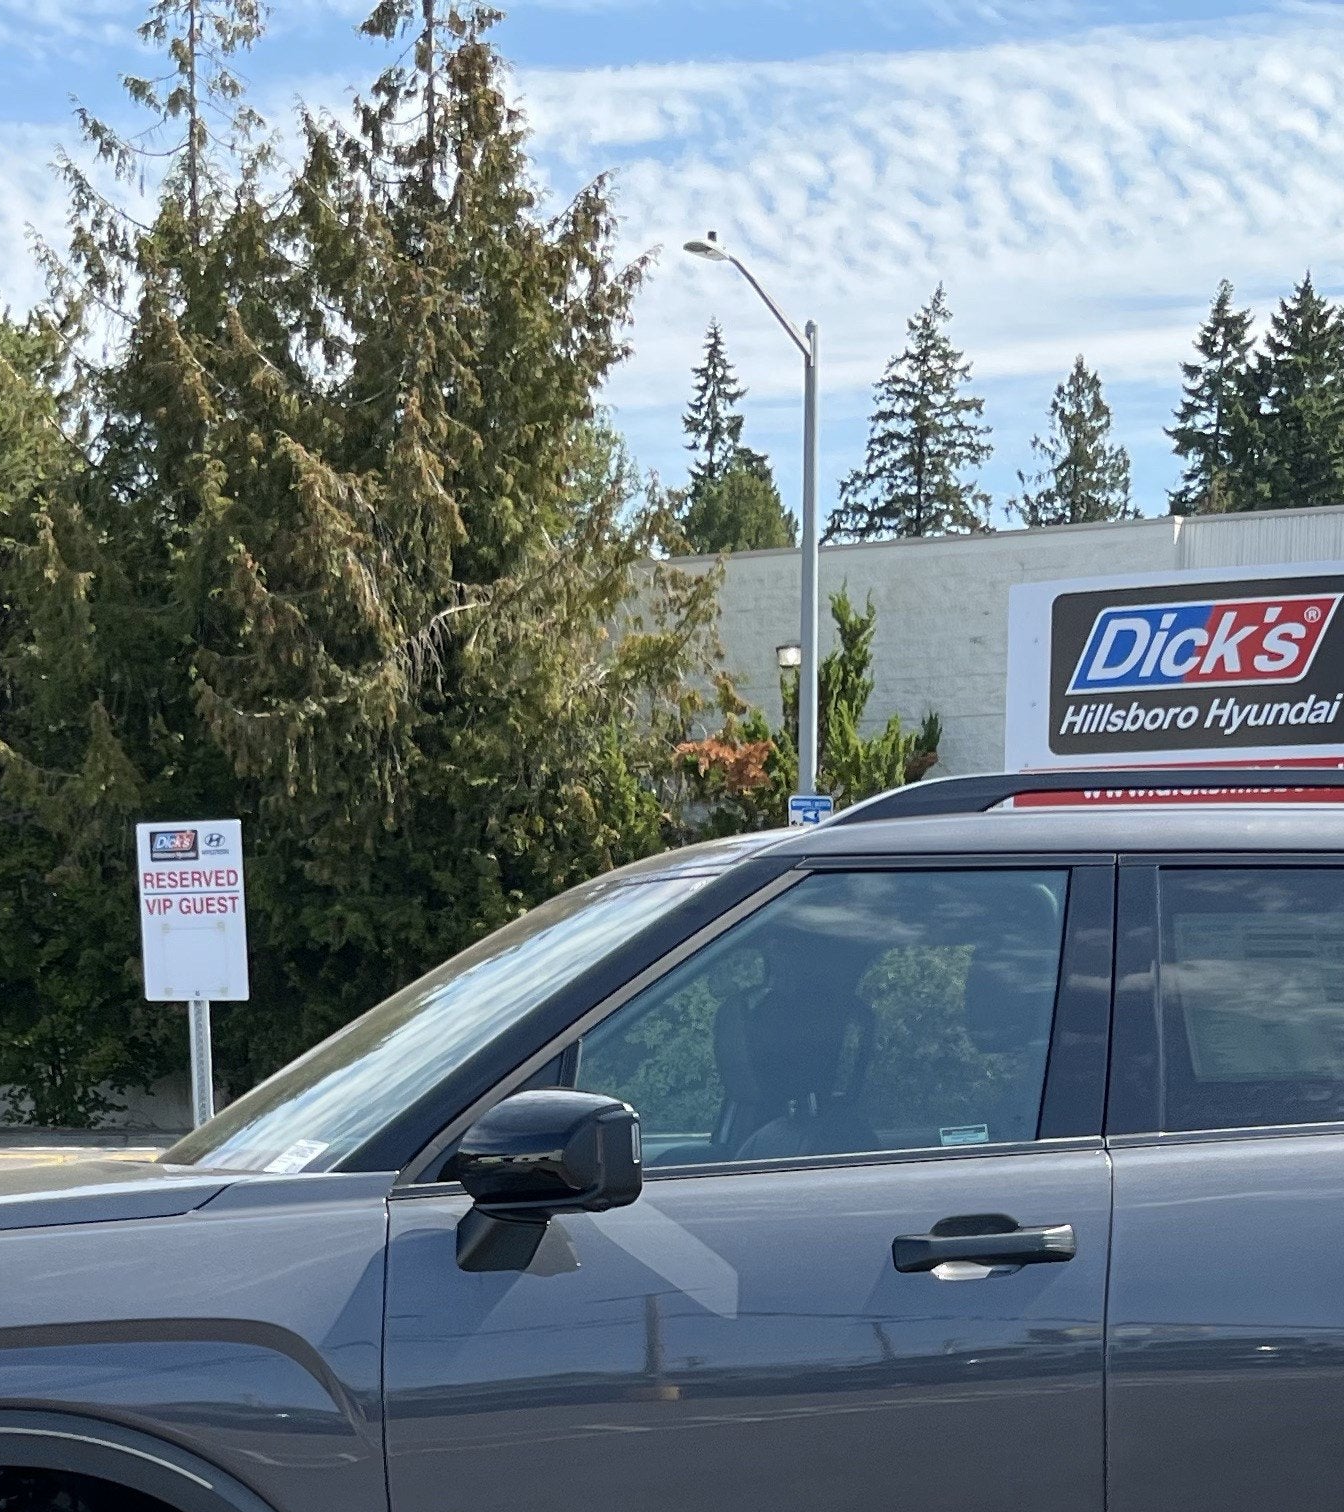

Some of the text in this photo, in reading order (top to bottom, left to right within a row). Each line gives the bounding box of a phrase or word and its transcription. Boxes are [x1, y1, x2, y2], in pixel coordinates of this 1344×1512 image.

[1059, 693, 1344, 735] Hillsboro Hyundai
[143, 869, 239, 889] RESERVED
[144, 896, 239, 915] VIP GUEST
